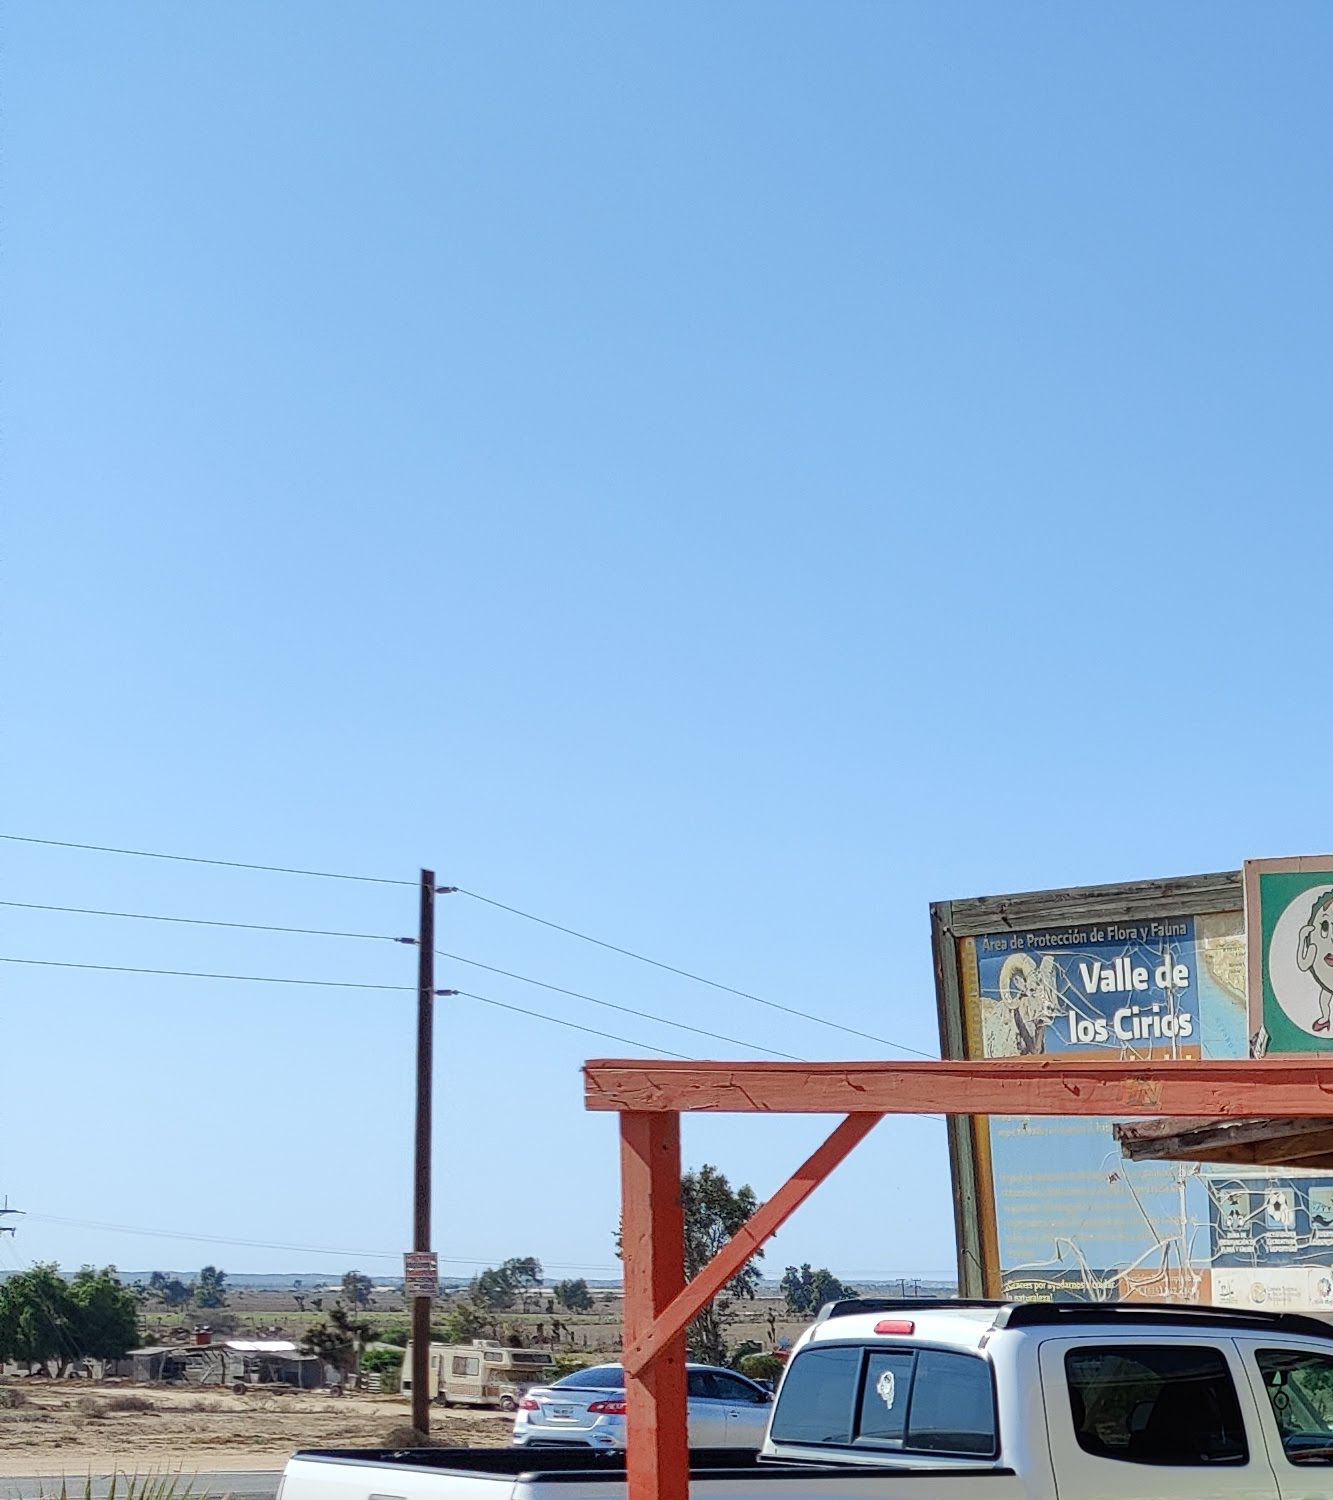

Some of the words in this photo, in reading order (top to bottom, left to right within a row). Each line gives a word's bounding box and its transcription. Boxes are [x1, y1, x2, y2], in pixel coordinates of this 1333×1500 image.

[982, 932, 1007, 950] Área
[1010, 935, 1024, 949] de
[1027, 928, 1087, 947] Protección
[1090, 927, 1105, 941] de
[1107, 925, 1138, 941] Flora
[1141, 928, 1148, 940] y
[1151, 922, 1187, 937] Fauna
[1080, 958, 1148, 993] Valle
[1155, 955, 1190, 988] de
[1069, 1011, 1107, 1043] los
[1113, 1007, 1192, 1041] Cirios
